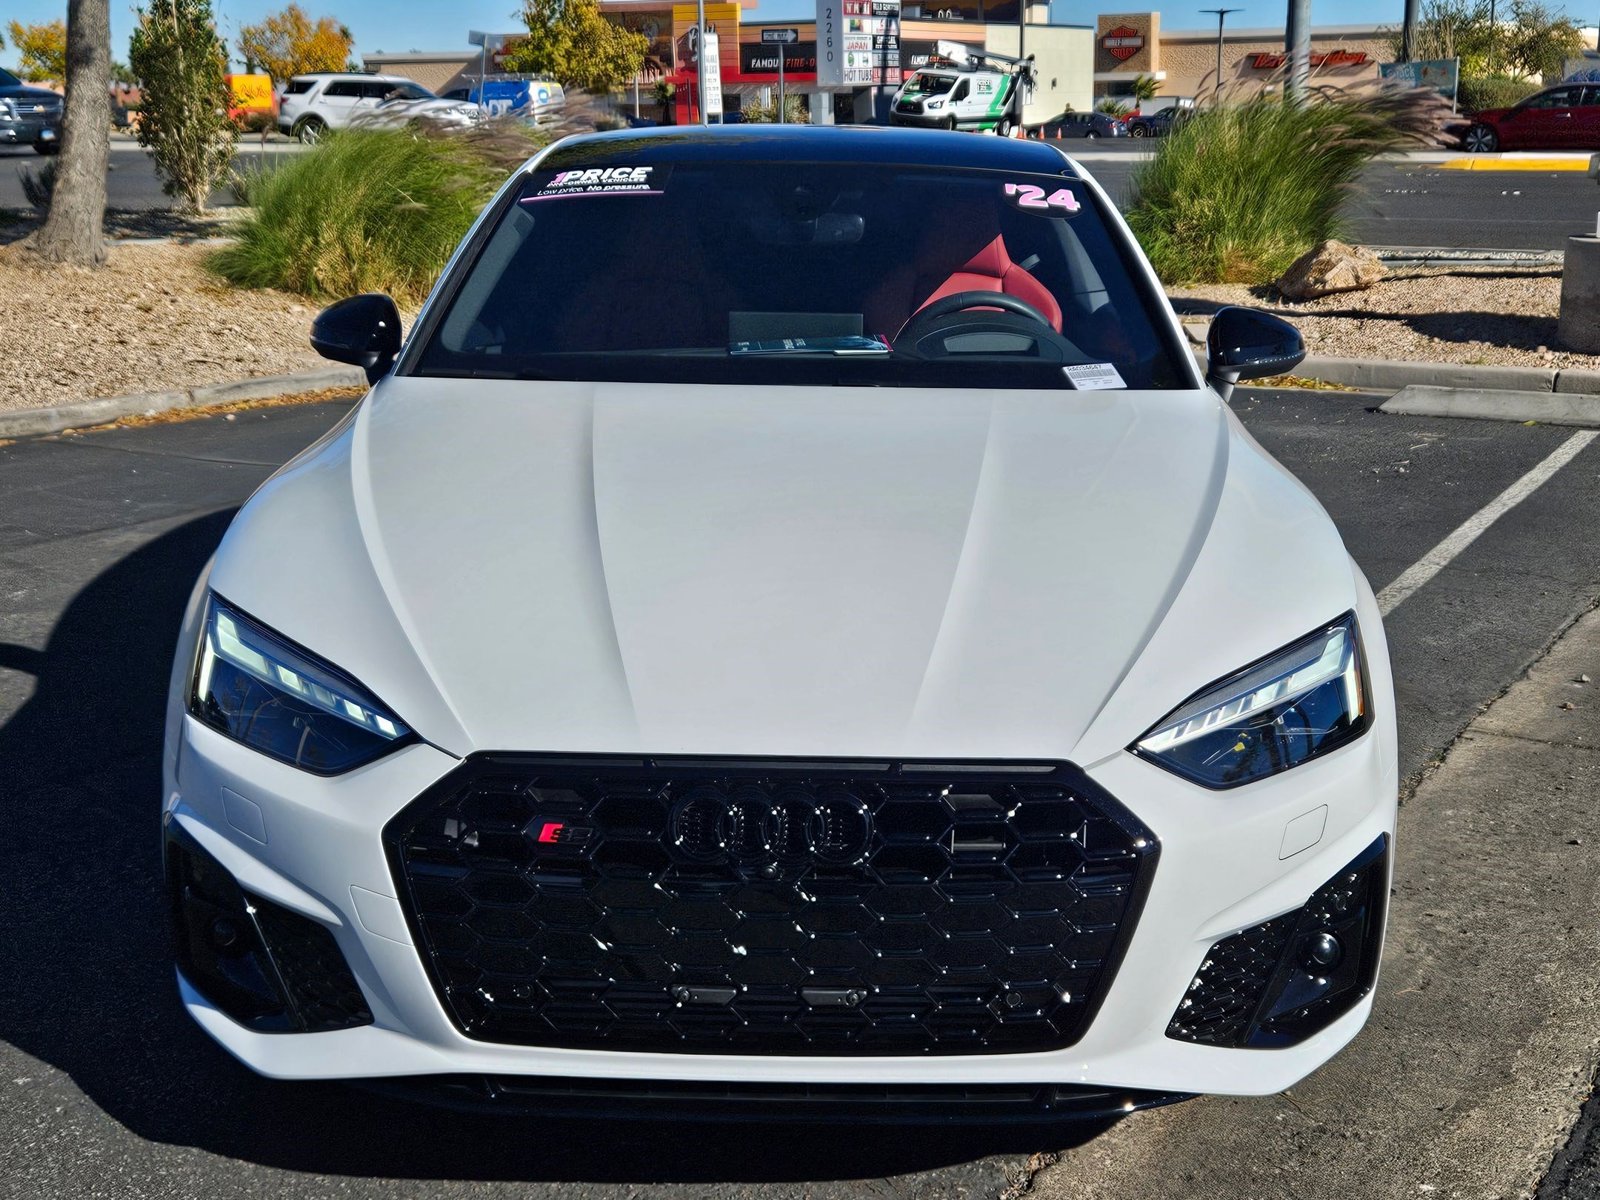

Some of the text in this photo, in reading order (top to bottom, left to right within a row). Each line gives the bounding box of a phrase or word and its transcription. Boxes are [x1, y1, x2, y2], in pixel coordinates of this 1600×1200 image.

[847, 41, 868, 50] JAPAN
[751, 58, 779, 68] FAMOU
[844, 70, 856, 80] HOT
[858, 70, 871, 80] TUBS
